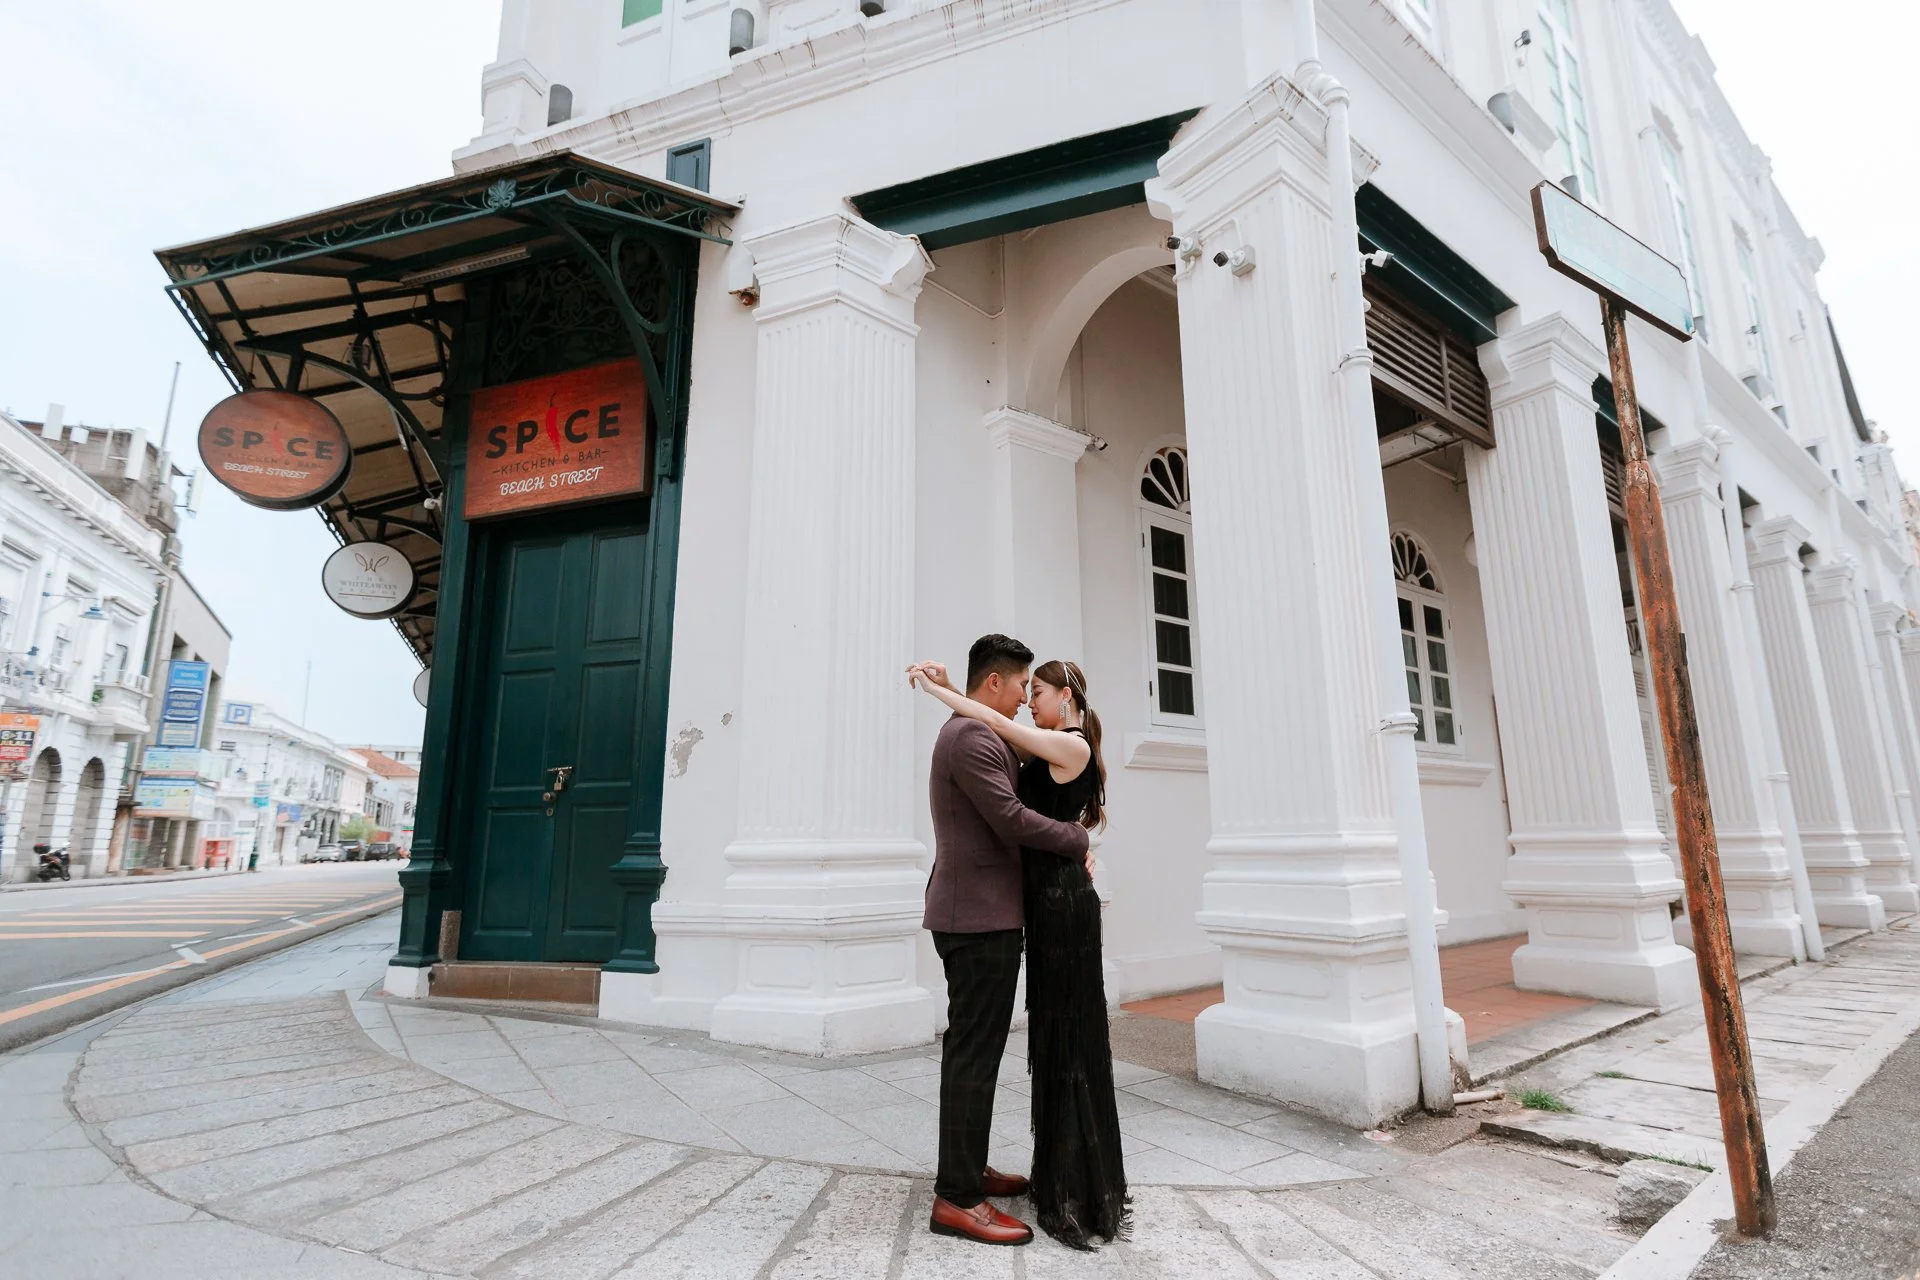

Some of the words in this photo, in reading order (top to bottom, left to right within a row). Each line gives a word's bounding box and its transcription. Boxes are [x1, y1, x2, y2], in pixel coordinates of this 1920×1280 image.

[265, 467, 311, 481] STREET
[500, 476, 545, 496] BEACH
[549, 466, 604, 488] STREET
[234, 708, 246, 720] P
